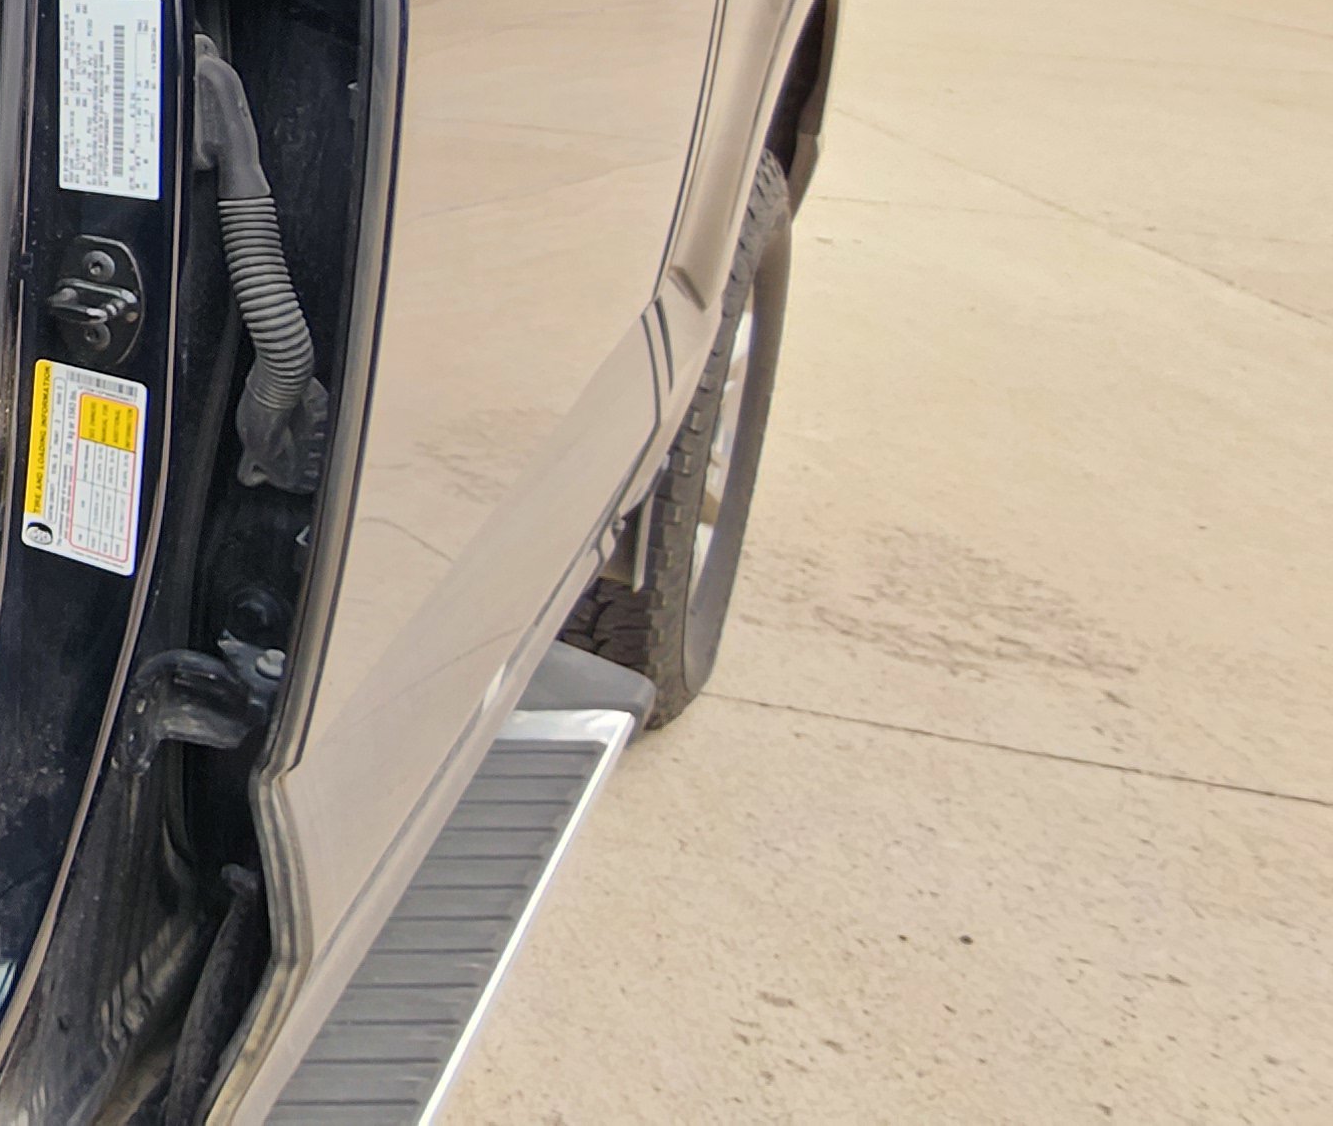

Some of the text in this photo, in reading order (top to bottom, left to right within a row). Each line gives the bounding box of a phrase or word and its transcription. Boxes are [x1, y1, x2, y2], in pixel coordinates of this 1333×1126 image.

[32, 365, 51, 514] TIRE AND LOADING INFORMATION
